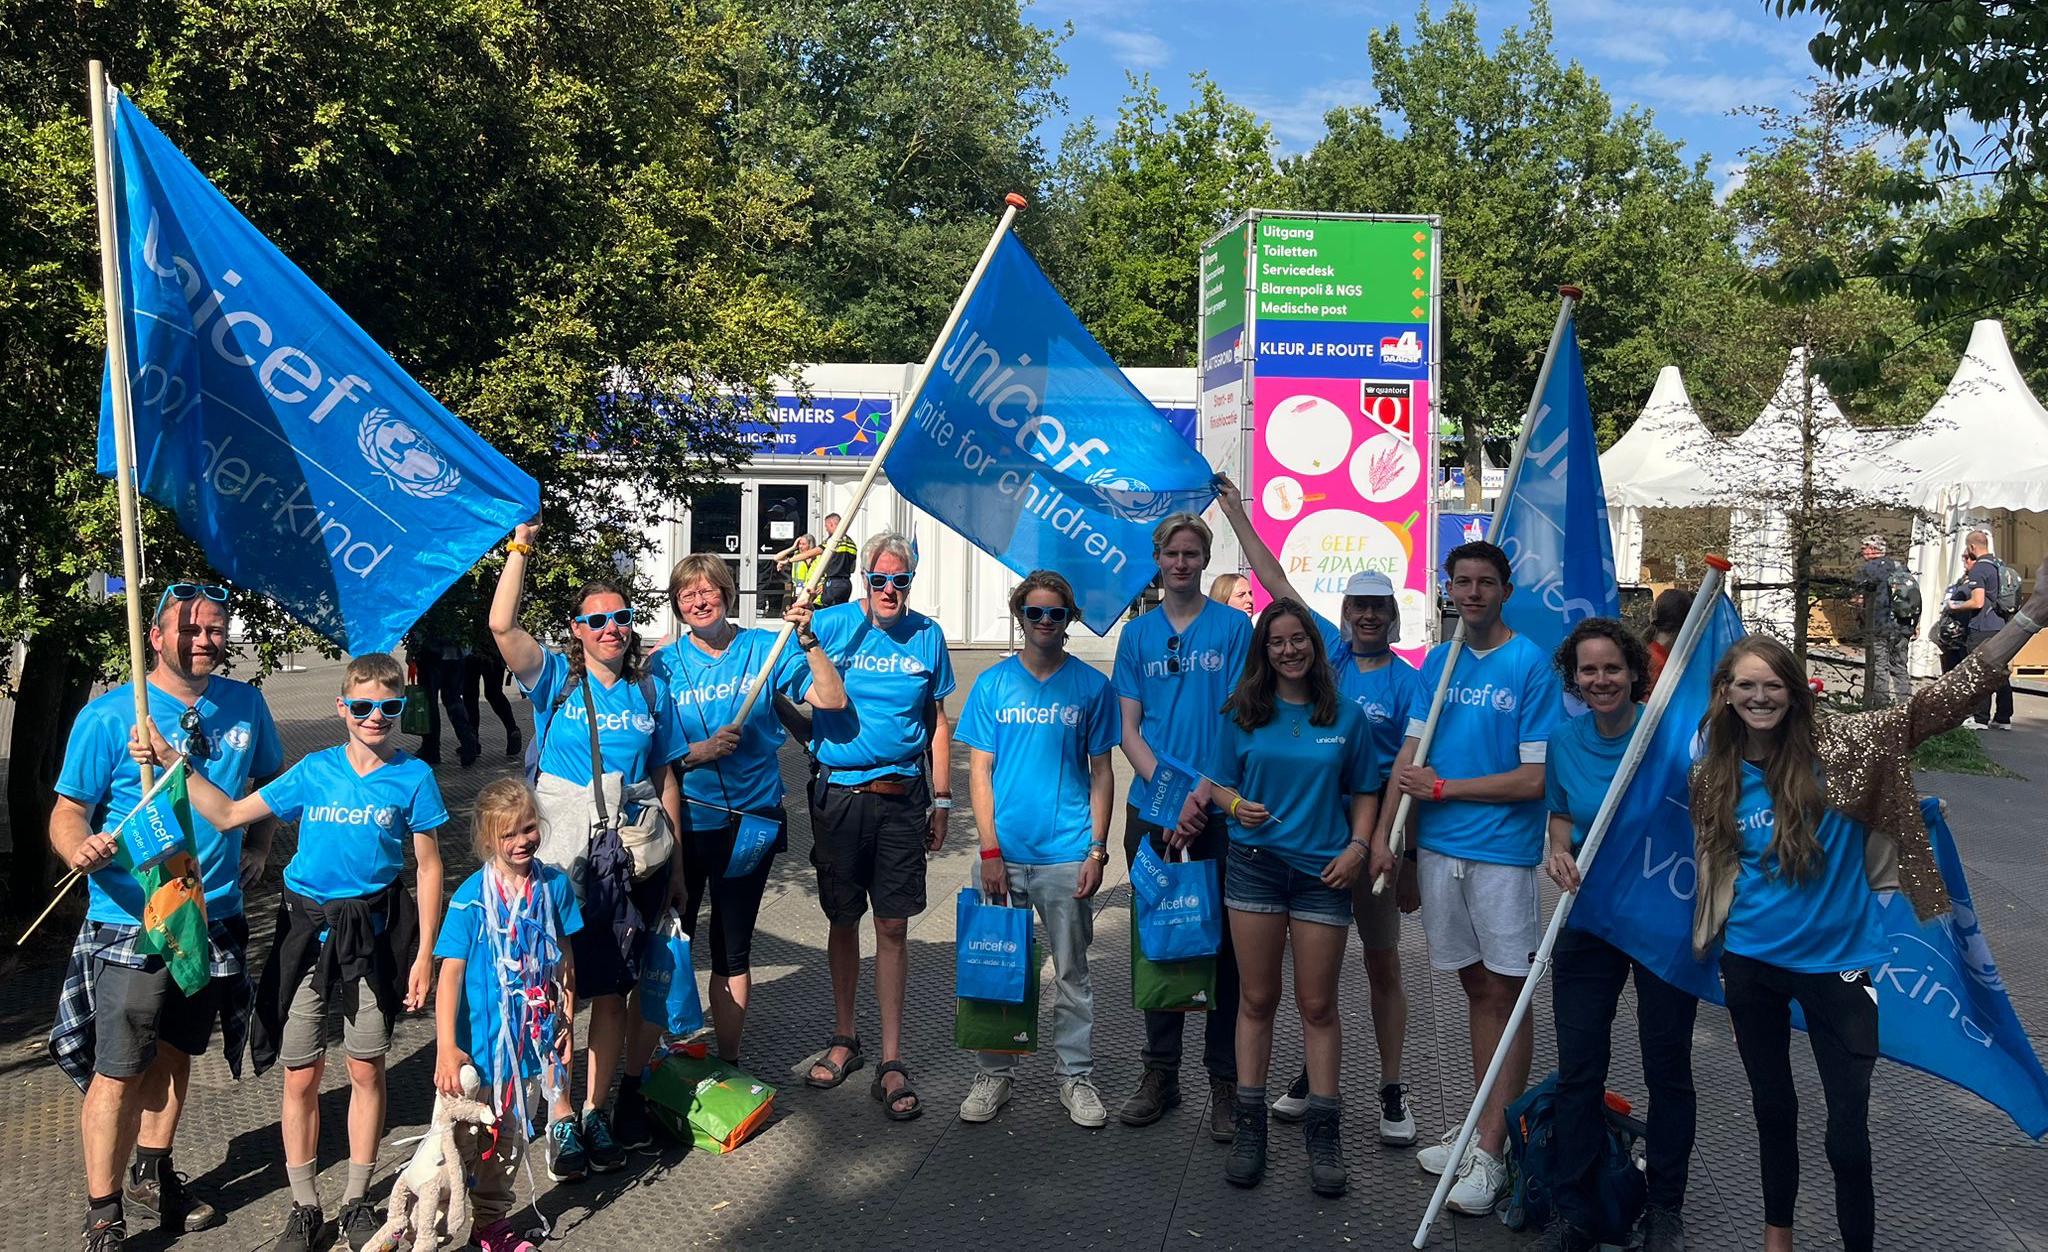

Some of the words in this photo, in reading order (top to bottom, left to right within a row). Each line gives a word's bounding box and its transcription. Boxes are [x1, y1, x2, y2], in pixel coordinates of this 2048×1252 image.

[1263, 225, 1314, 240] Uitgang
[1263, 245, 1317, 258] Toiletten
[1262, 264, 1334, 277] Servicedesk
[1261, 283, 1323, 297] Blarenpoli
[1325, 285, 1334, 296] &
[1336, 285, 1362, 297] NGS
[1261, 301, 1319, 315] Medische
[1321, 304, 1347, 316] post
[1260, 342, 1305, 356] KLEUR
[1308, 344, 1324, 357] JE
[1327, 344, 1374, 357] ROUTE
[1383, 355, 1419, 363] DAAGSE
[942, 319, 1109, 474] unicef
[955, 429, 997, 476] for
[998, 470, 1127, 574] children
[272, 484, 393, 579] kind
[1321, 535, 1369, 552] GEEF
[1288, 556, 1312, 573] DE
[1317, 556, 1399, 573] 4DAAGSE
[671, 681, 738, 706] unicef
[996, 702, 1058, 724] unicef
[1316, 736, 1338, 744] unicef
[1150, 780, 1169, 817] unicef
[308, 801, 372, 826] unicef
[968, 939, 1003, 952] unicef
